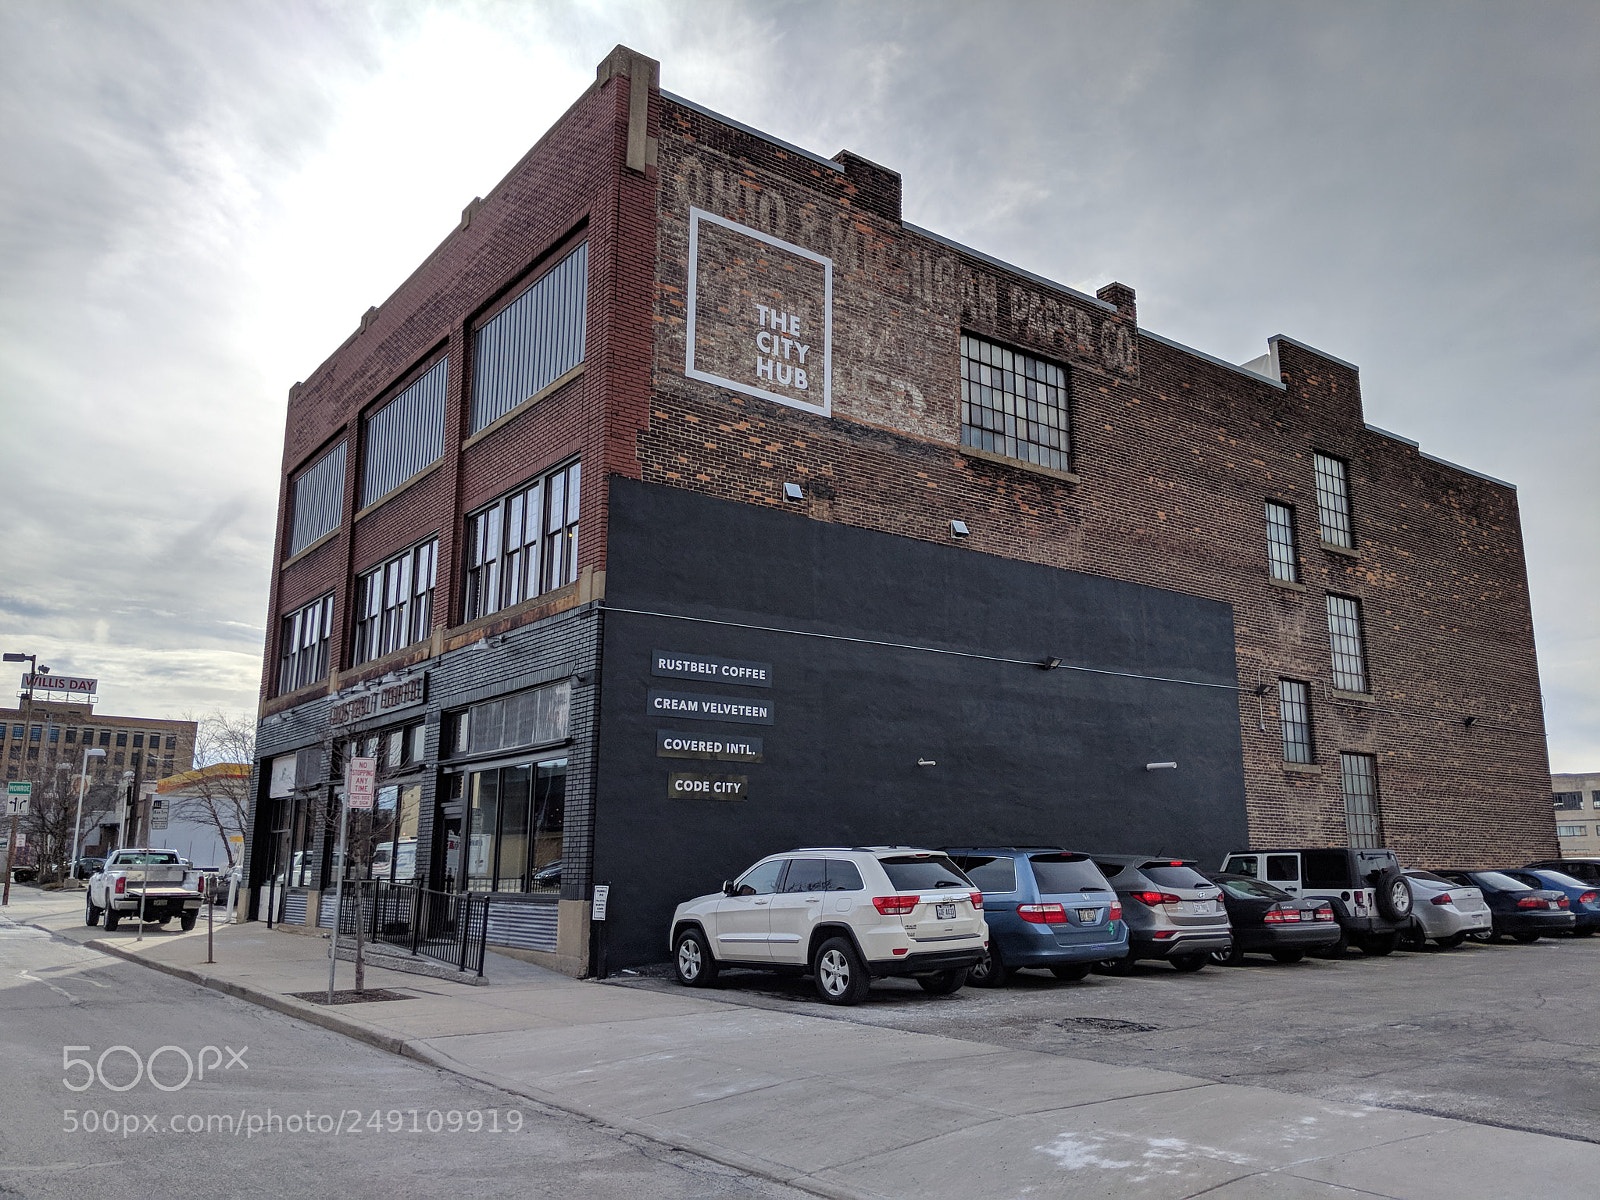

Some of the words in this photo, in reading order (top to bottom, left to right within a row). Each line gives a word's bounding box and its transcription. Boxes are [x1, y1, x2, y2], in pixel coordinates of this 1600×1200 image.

[756, 303, 801, 337] THE
[756, 331, 810, 364] CITY
[756, 356, 808, 390] HUB
[658, 659, 718, 674] RUSTBELT
[721, 666, 767, 680] COFFEE
[25, 676, 65, 689] WILLIS
[69, 679, 95, 691] DAY
[654, 698, 699, 712] CREAM
[702, 702, 768, 718] VELVETEEN
[663, 738, 722, 753] COVERED
[726, 743, 756, 755] INTL.
[9, 784, 31, 792] MONROE
[674, 779, 710, 792] CODE
[713, 782, 742, 794] CITY
